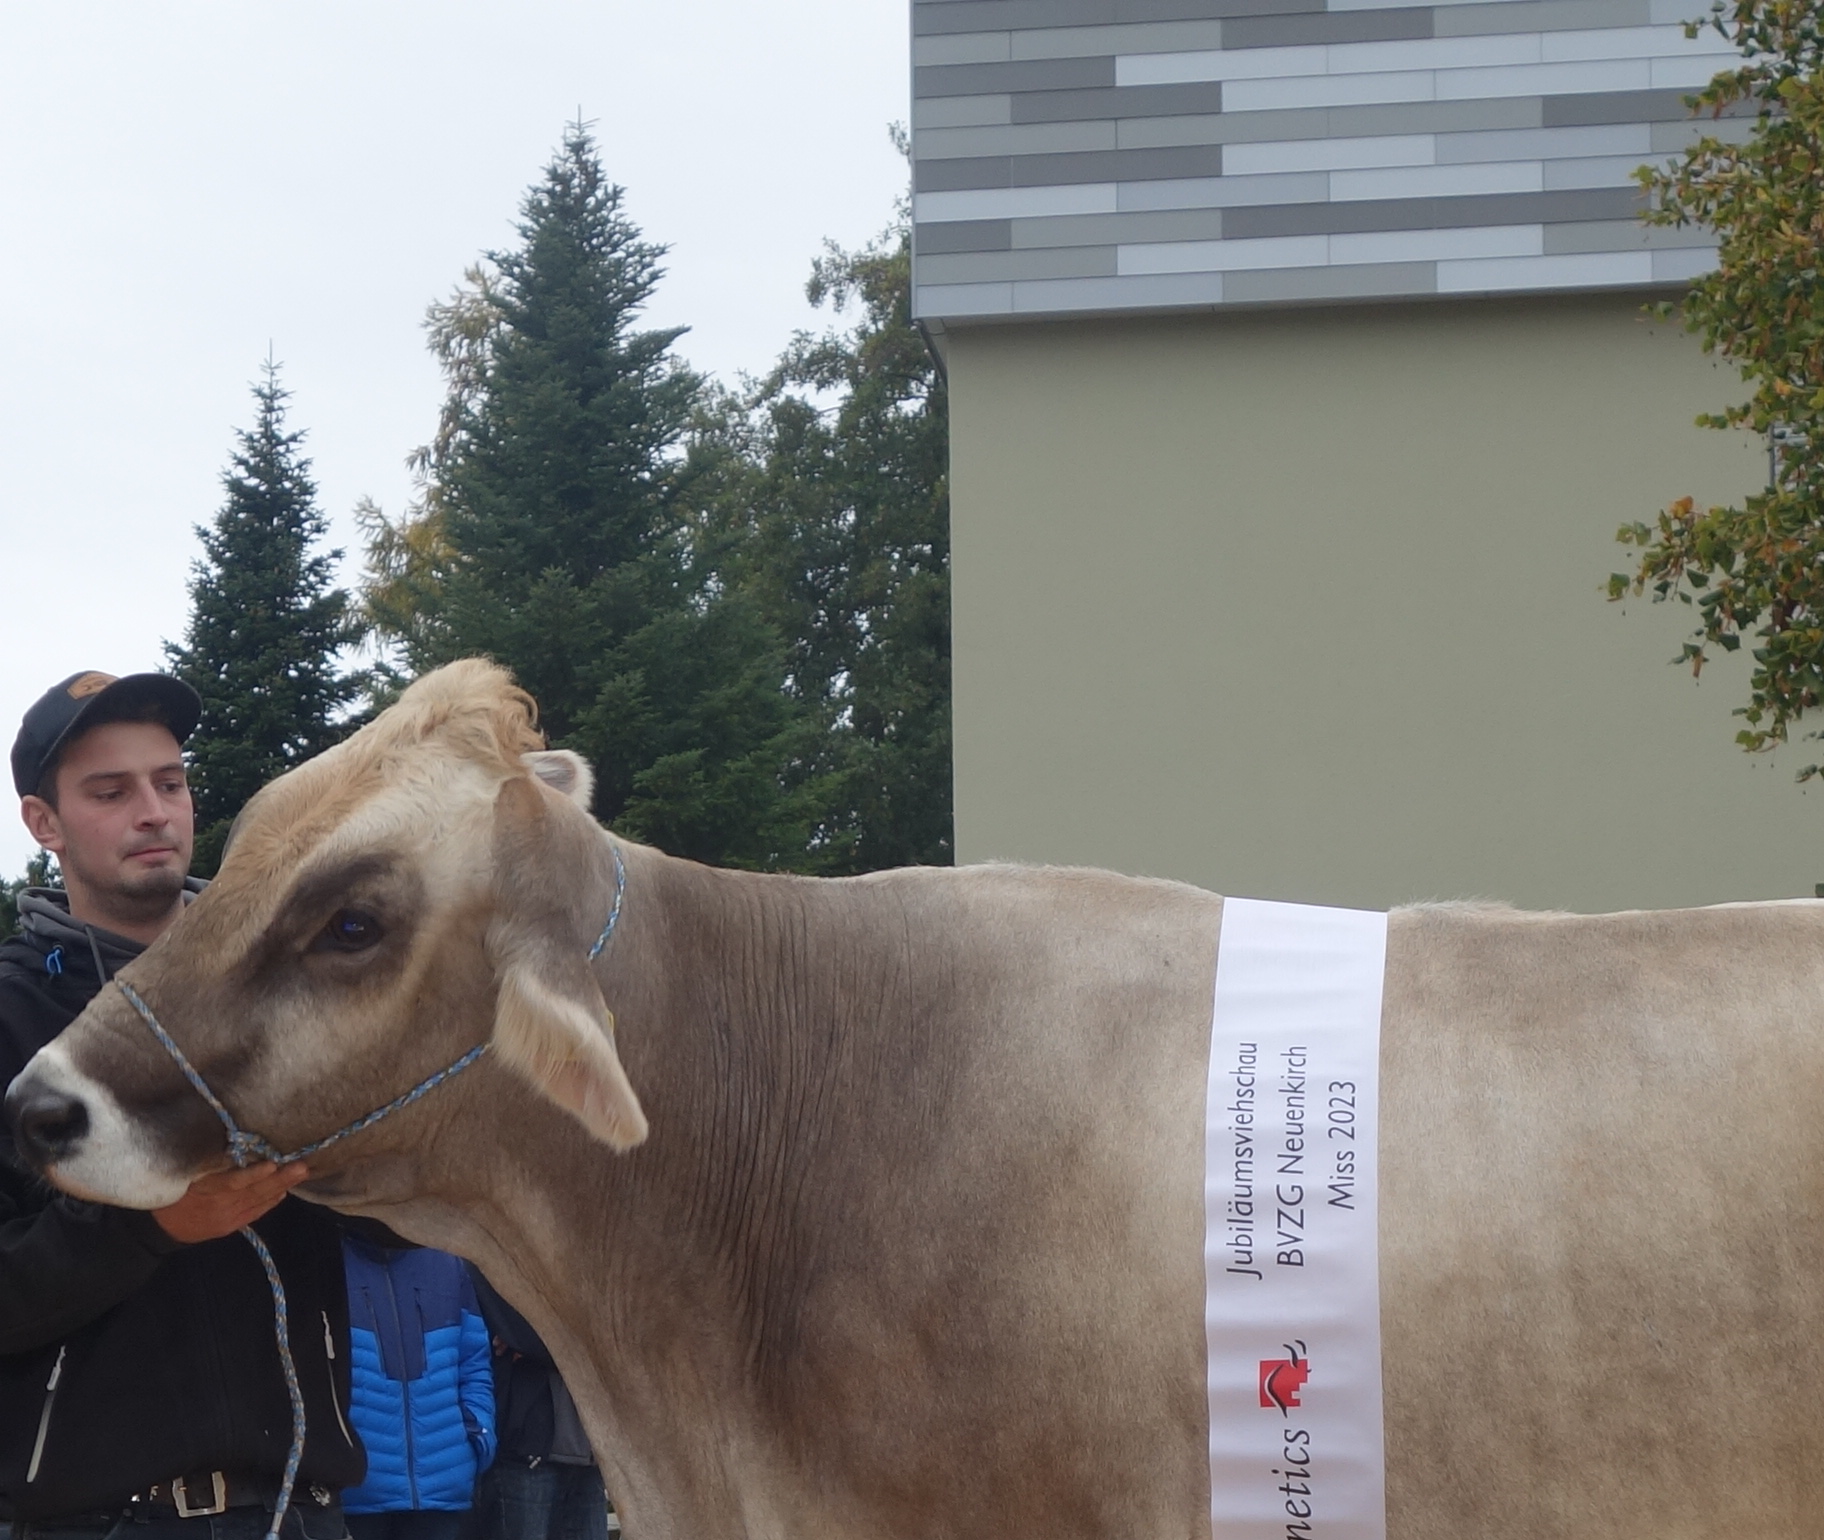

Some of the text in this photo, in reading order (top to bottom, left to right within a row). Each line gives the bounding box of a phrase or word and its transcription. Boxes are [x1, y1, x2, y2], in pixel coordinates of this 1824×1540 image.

[1226, 1042, 1263, 1281] Jubiläumsviehschau
[1275, 1046, 1307, 1267] BVZG Neuenkirch
[1327, 1081, 1357, 1211] Miss 2023
